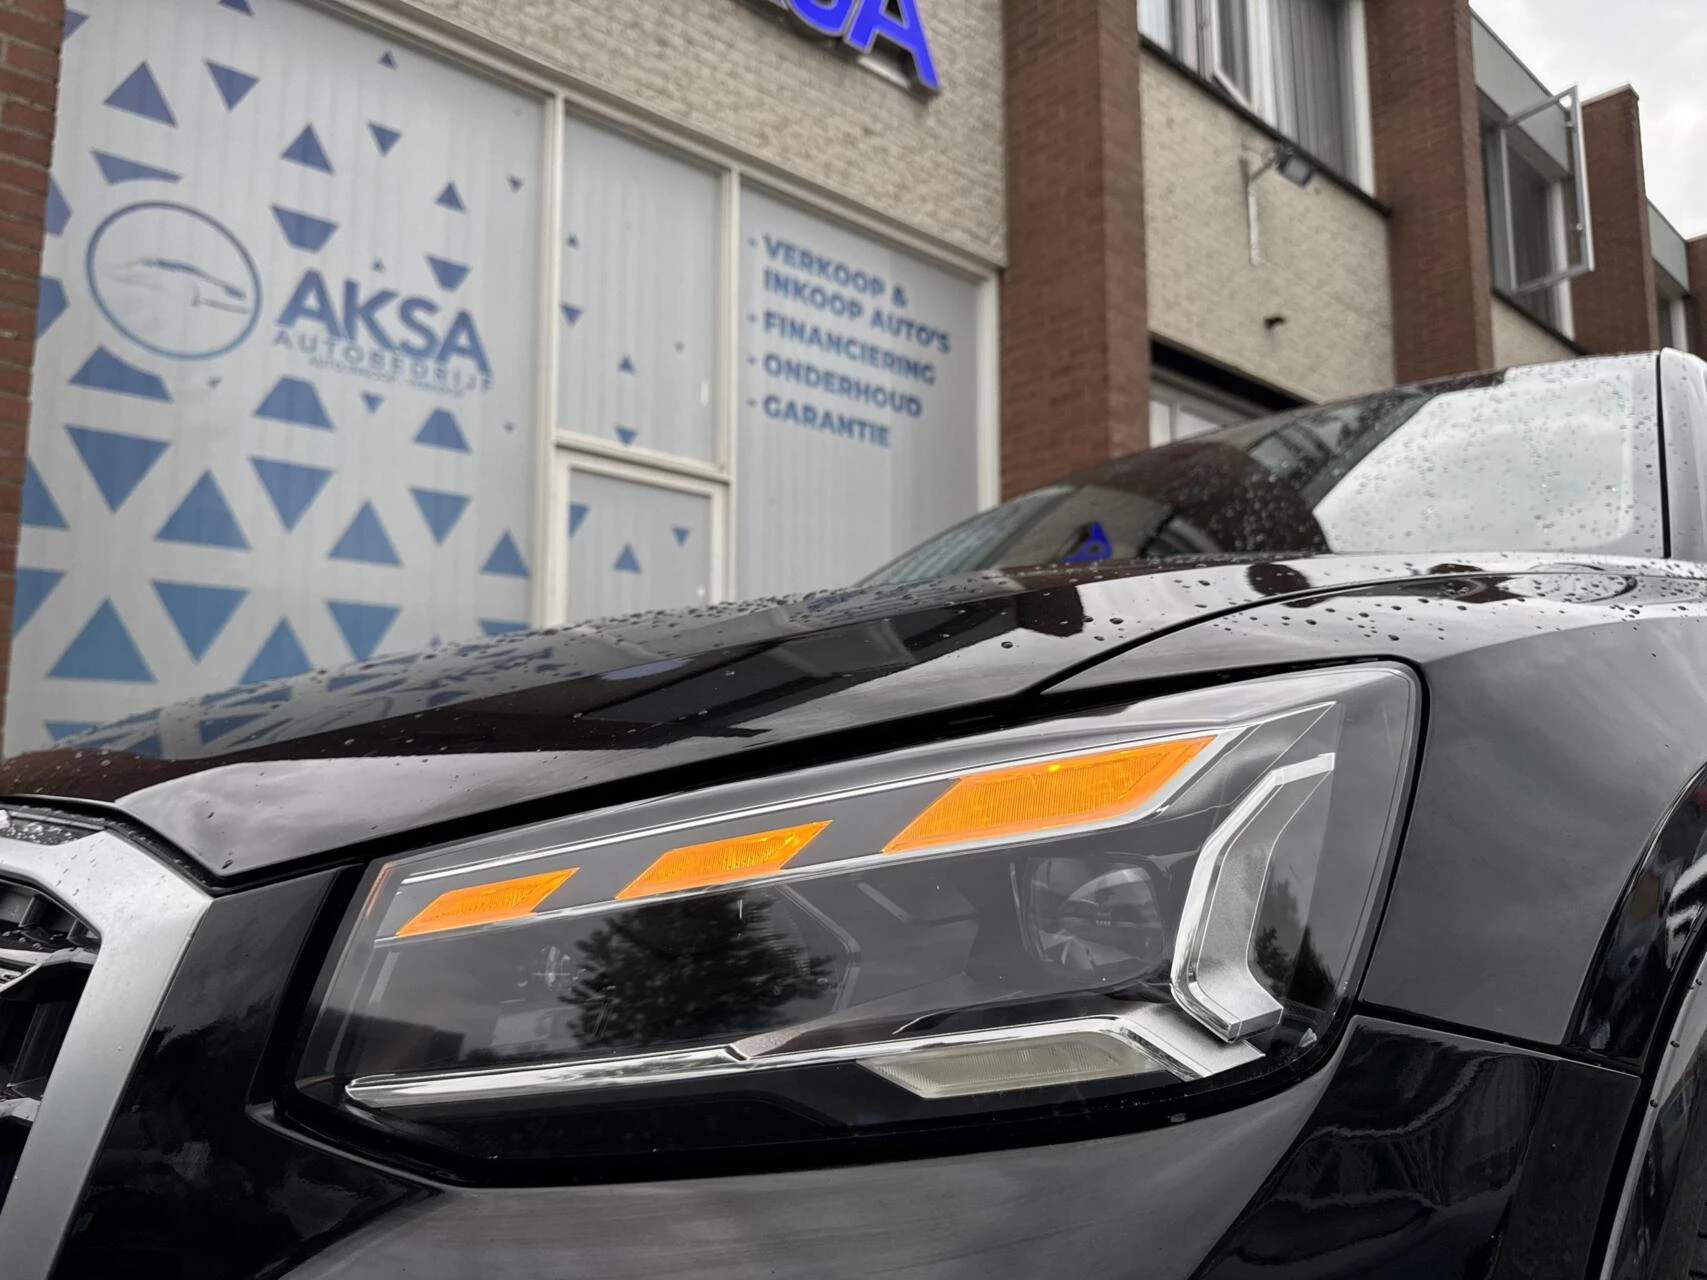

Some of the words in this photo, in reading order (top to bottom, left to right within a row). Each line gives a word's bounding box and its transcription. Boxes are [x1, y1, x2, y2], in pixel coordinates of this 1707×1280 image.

[762, 232, 885, 298] VERKOOP
[891, 285, 908, 308] &
[276, 268, 492, 376] AKSA
[762, 267, 863, 321] INKOOP
[869, 307, 952, 355] AUTO'S
[762, 310, 936, 386] FINANCIERING
[762, 352, 924, 418] ONDERHOUD
[762, 394, 890, 447] GARANTIE
